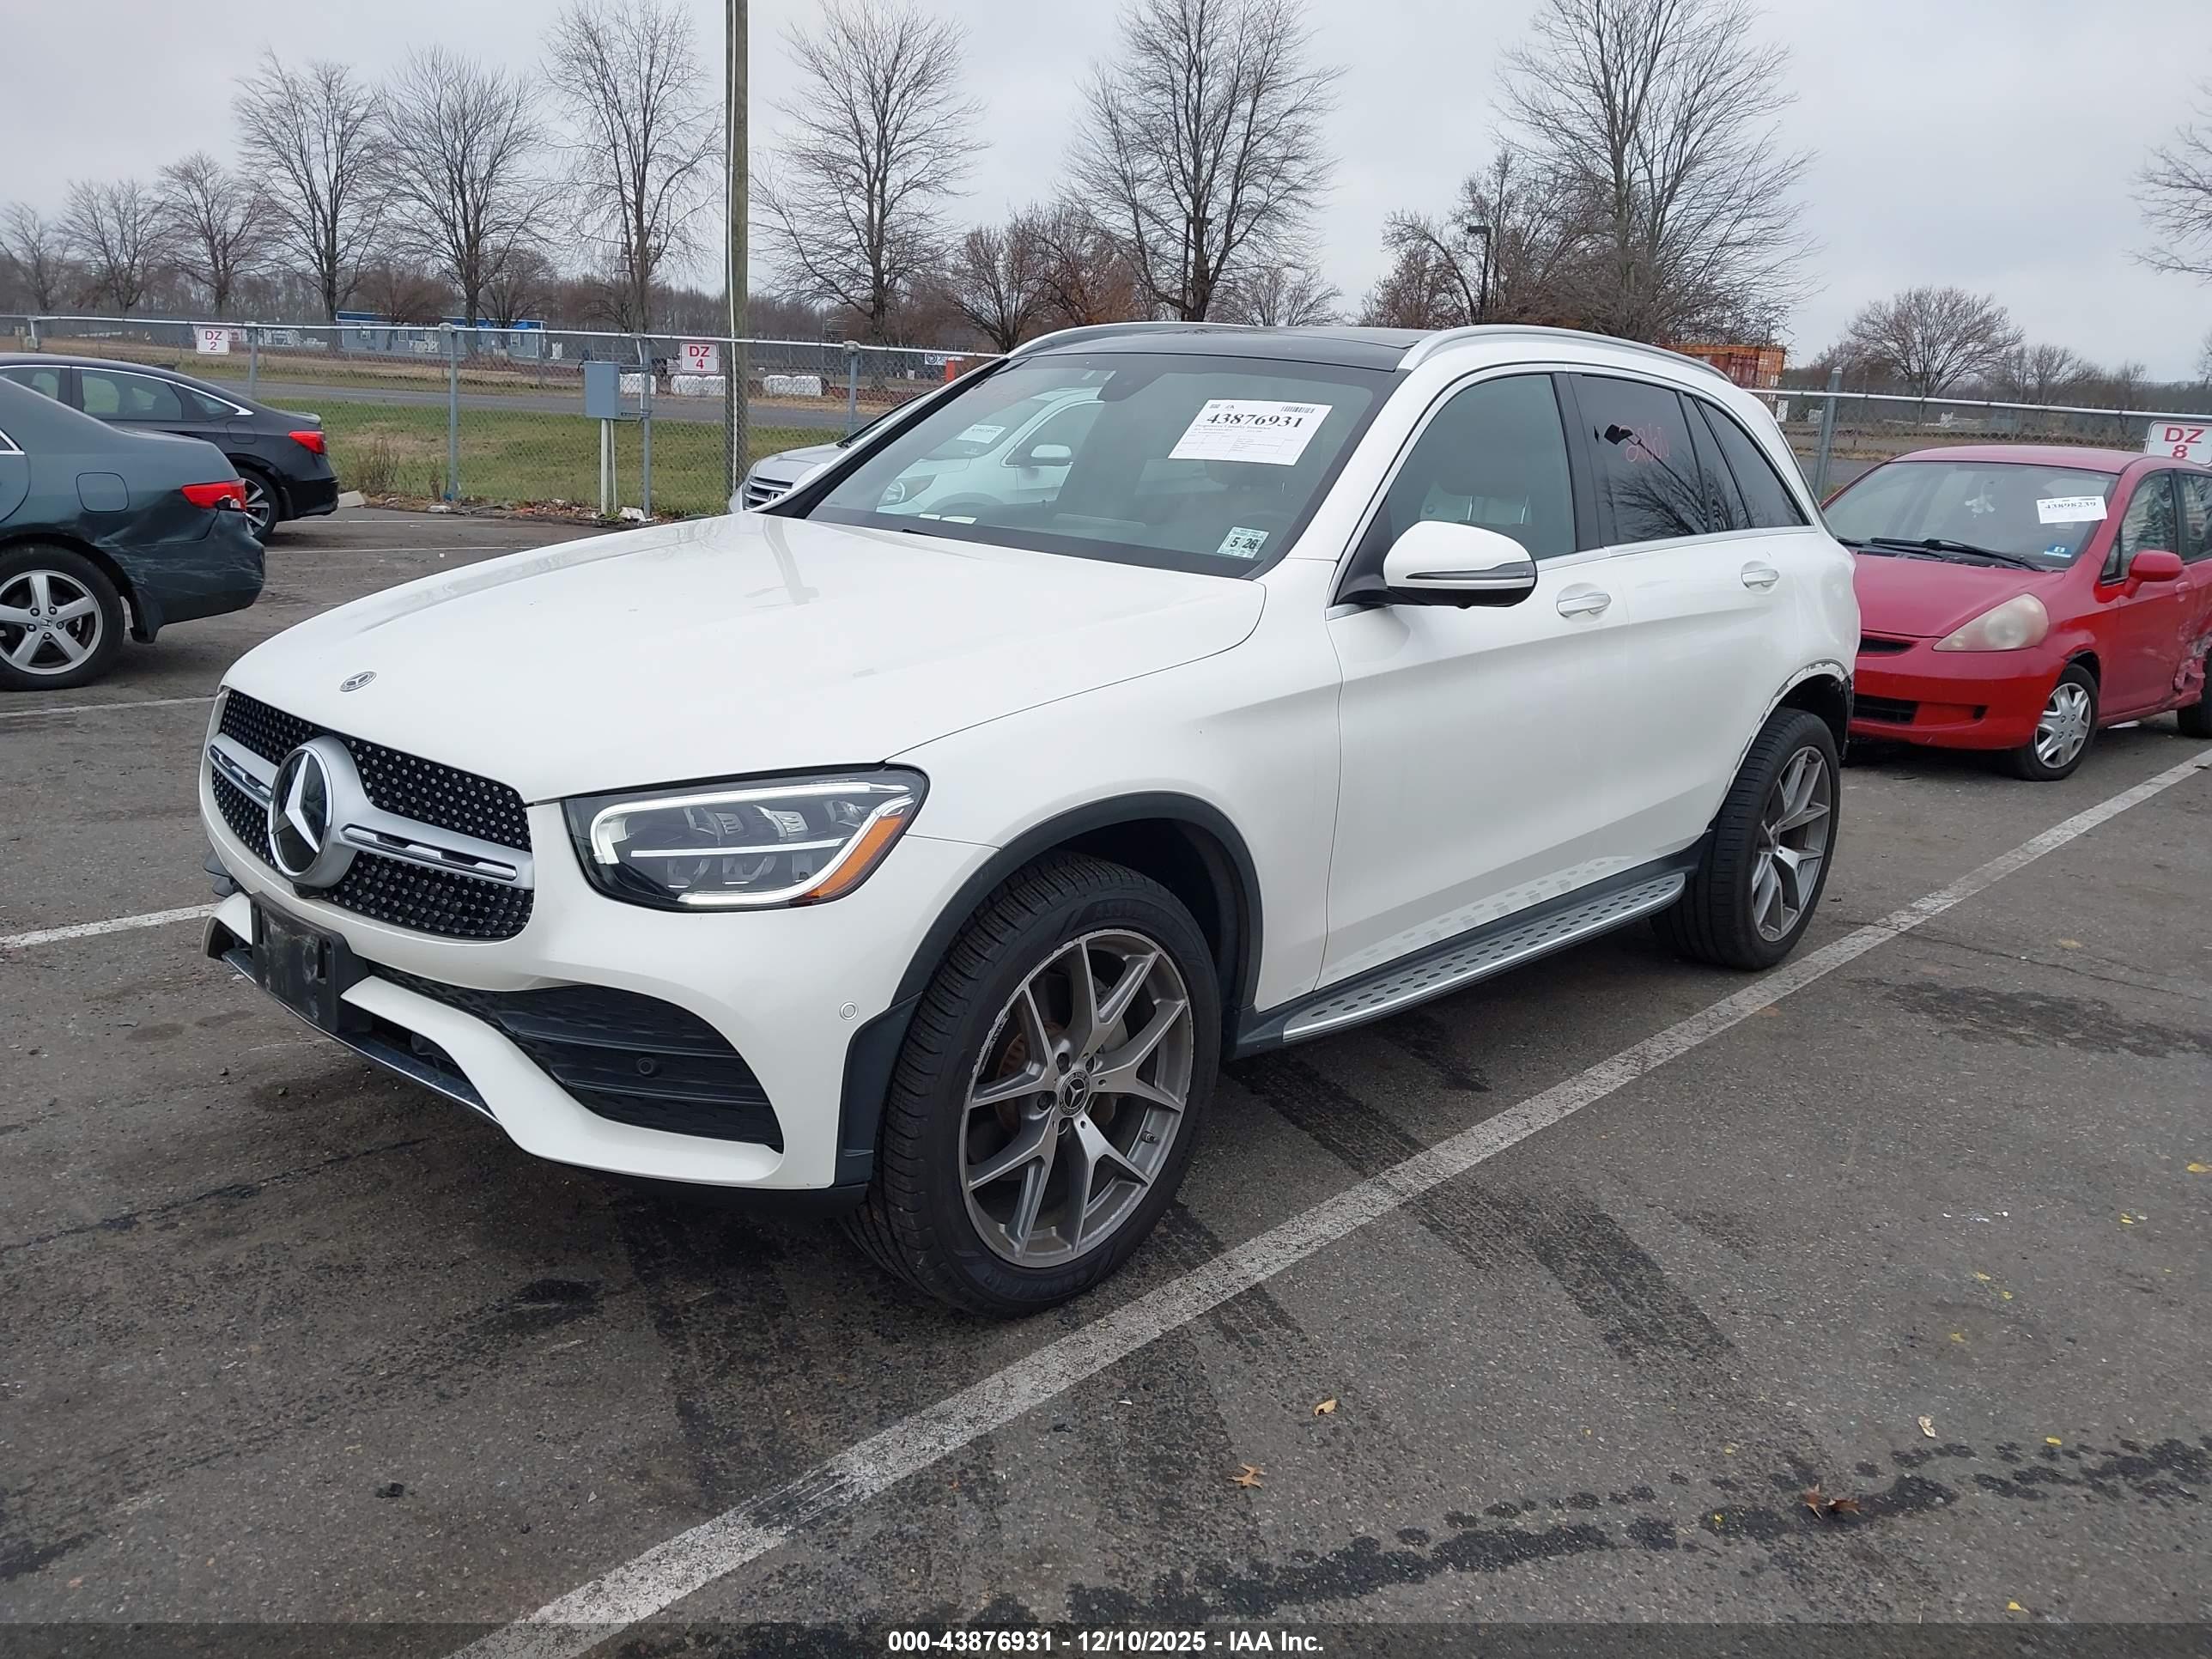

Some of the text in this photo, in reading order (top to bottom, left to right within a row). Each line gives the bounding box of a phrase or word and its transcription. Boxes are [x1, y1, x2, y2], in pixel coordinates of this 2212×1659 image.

[205, 331, 222, 340] DZ
[210, 342, 217, 350] 2
[689, 345, 710, 357] DZ
[696, 359, 704, 369] 4
[1206, 412, 1304, 428] 43876931
[2164, 427, 2205, 443] DZ
[2172, 444, 2188, 459] 8
[1231, 536, 1259, 550] 5 26
